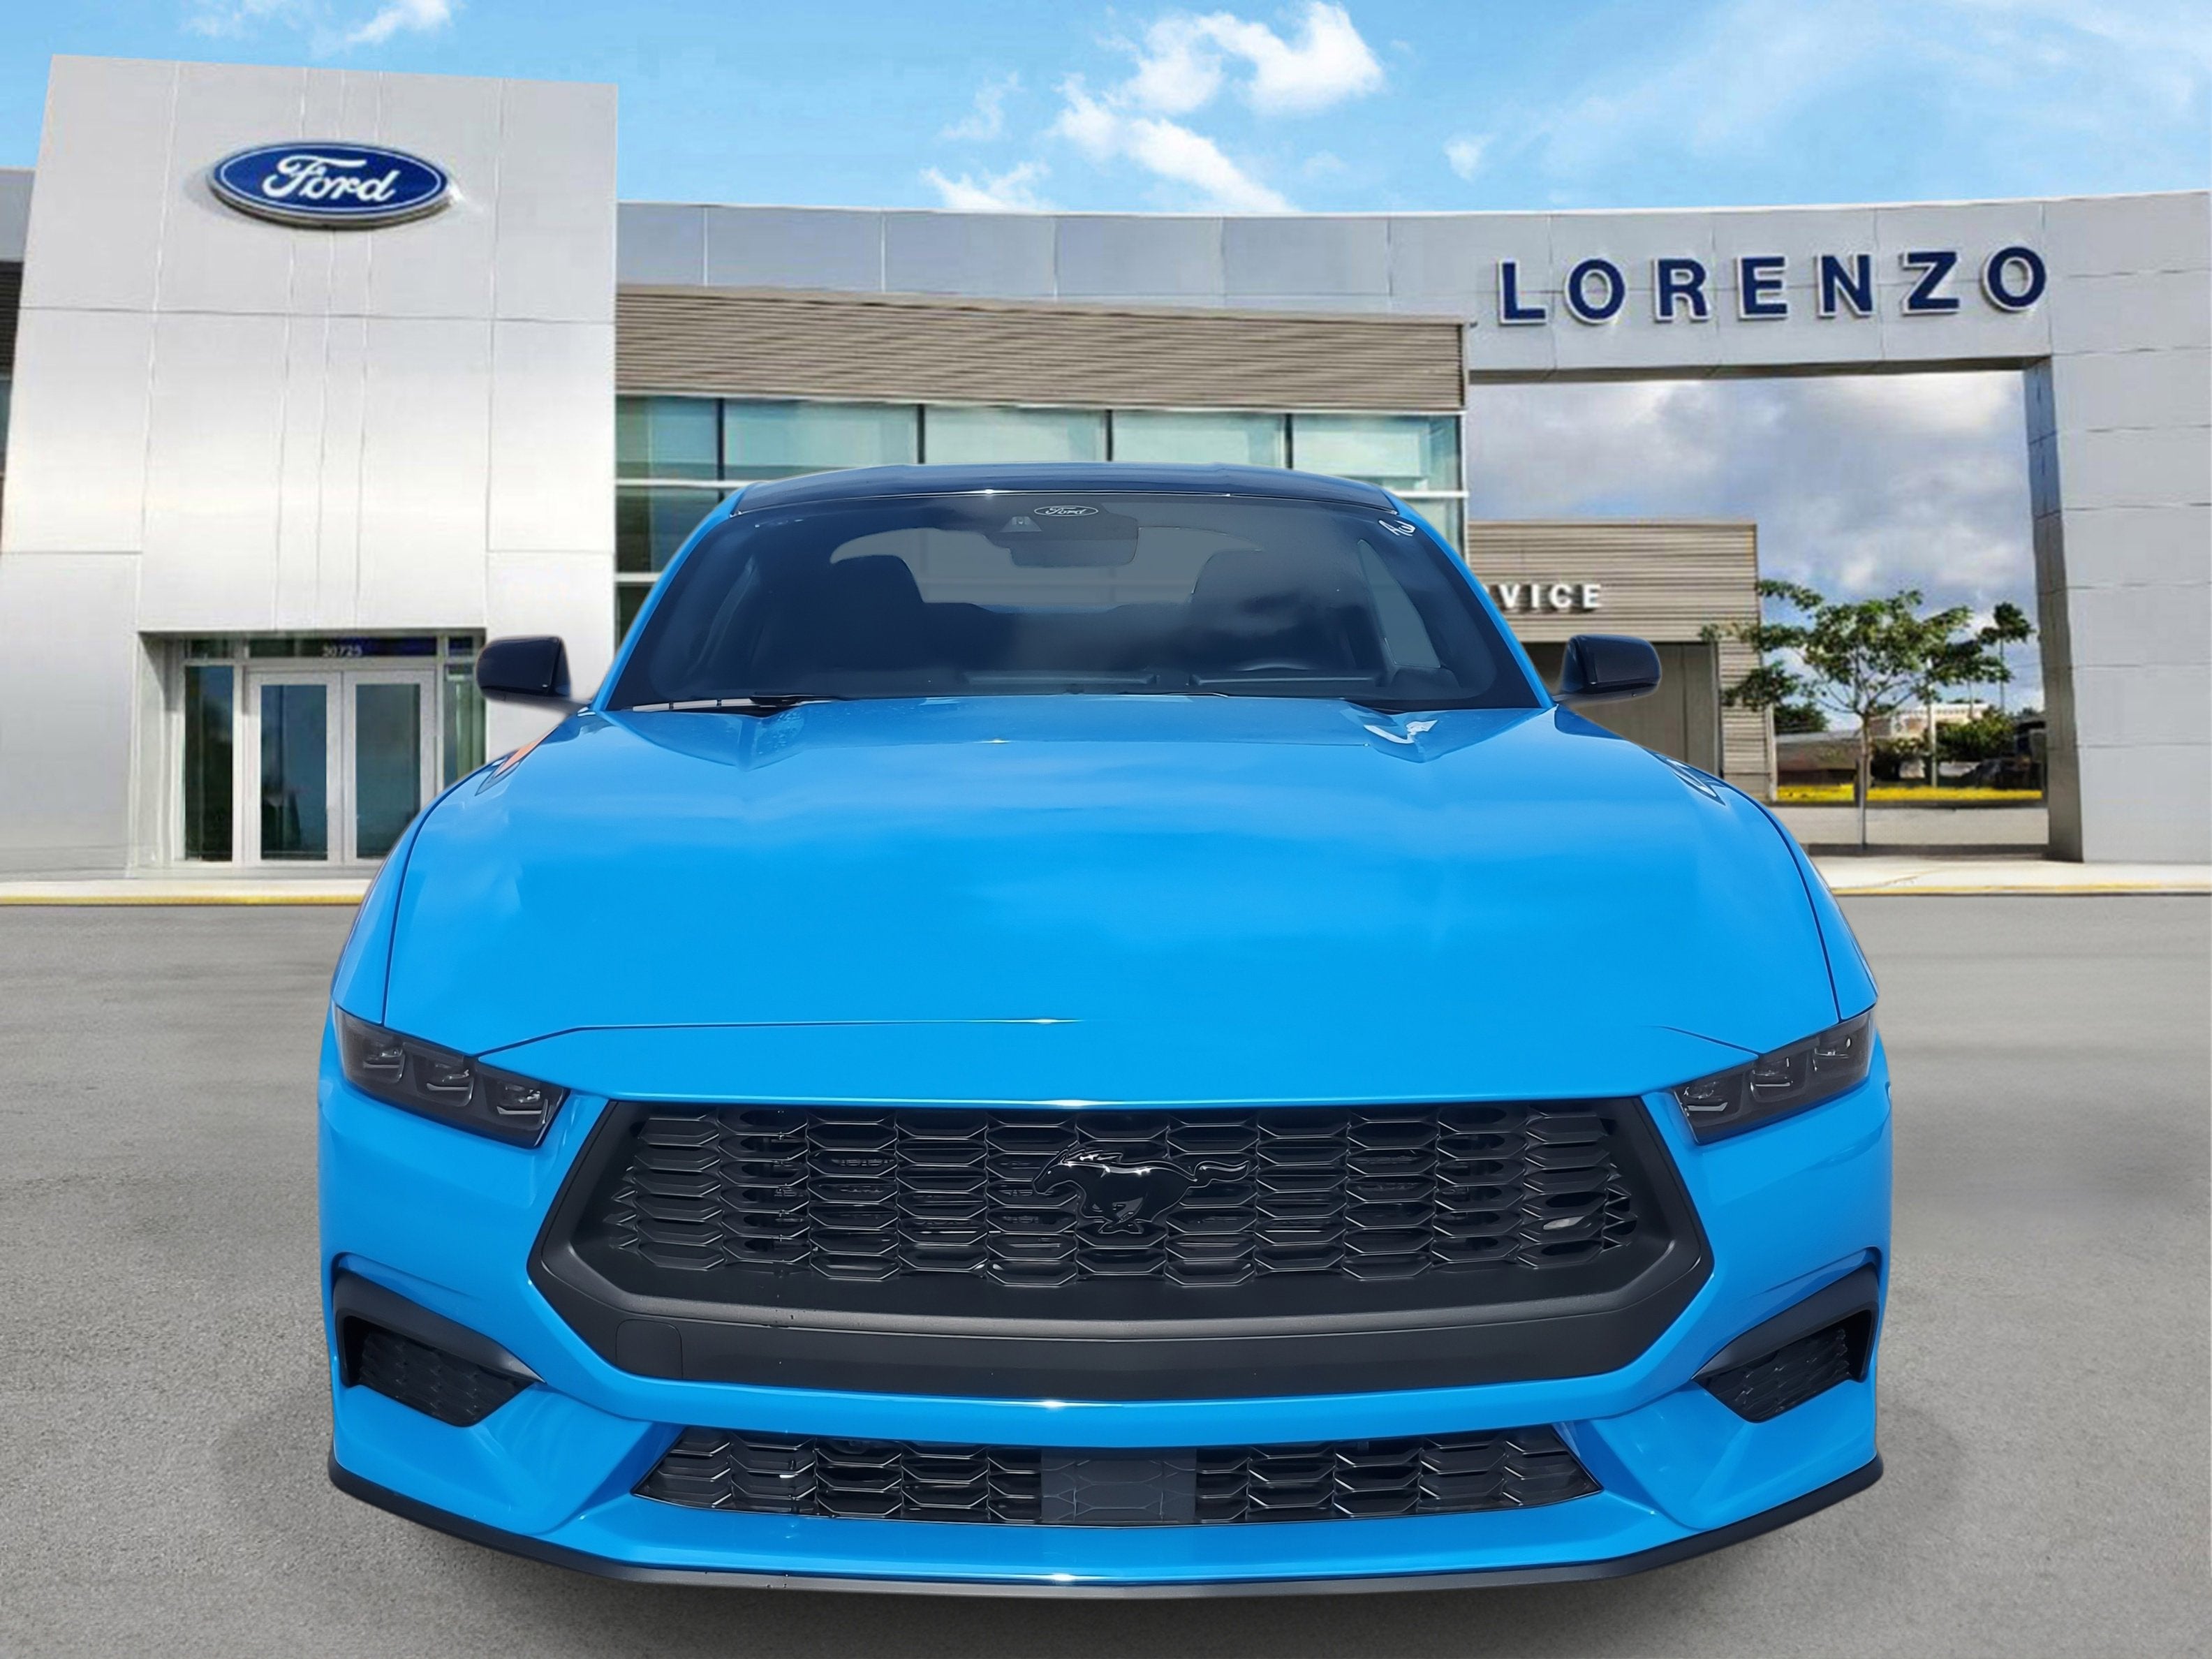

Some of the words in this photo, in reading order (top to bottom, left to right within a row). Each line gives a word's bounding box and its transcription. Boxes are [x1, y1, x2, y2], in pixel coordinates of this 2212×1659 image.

[262, 154, 401, 202] Ford
[1498, 245, 2047, 325] LORENZO
[1045, 507, 1086, 515] Ford
[1483, 582, 1602, 610] VICE
